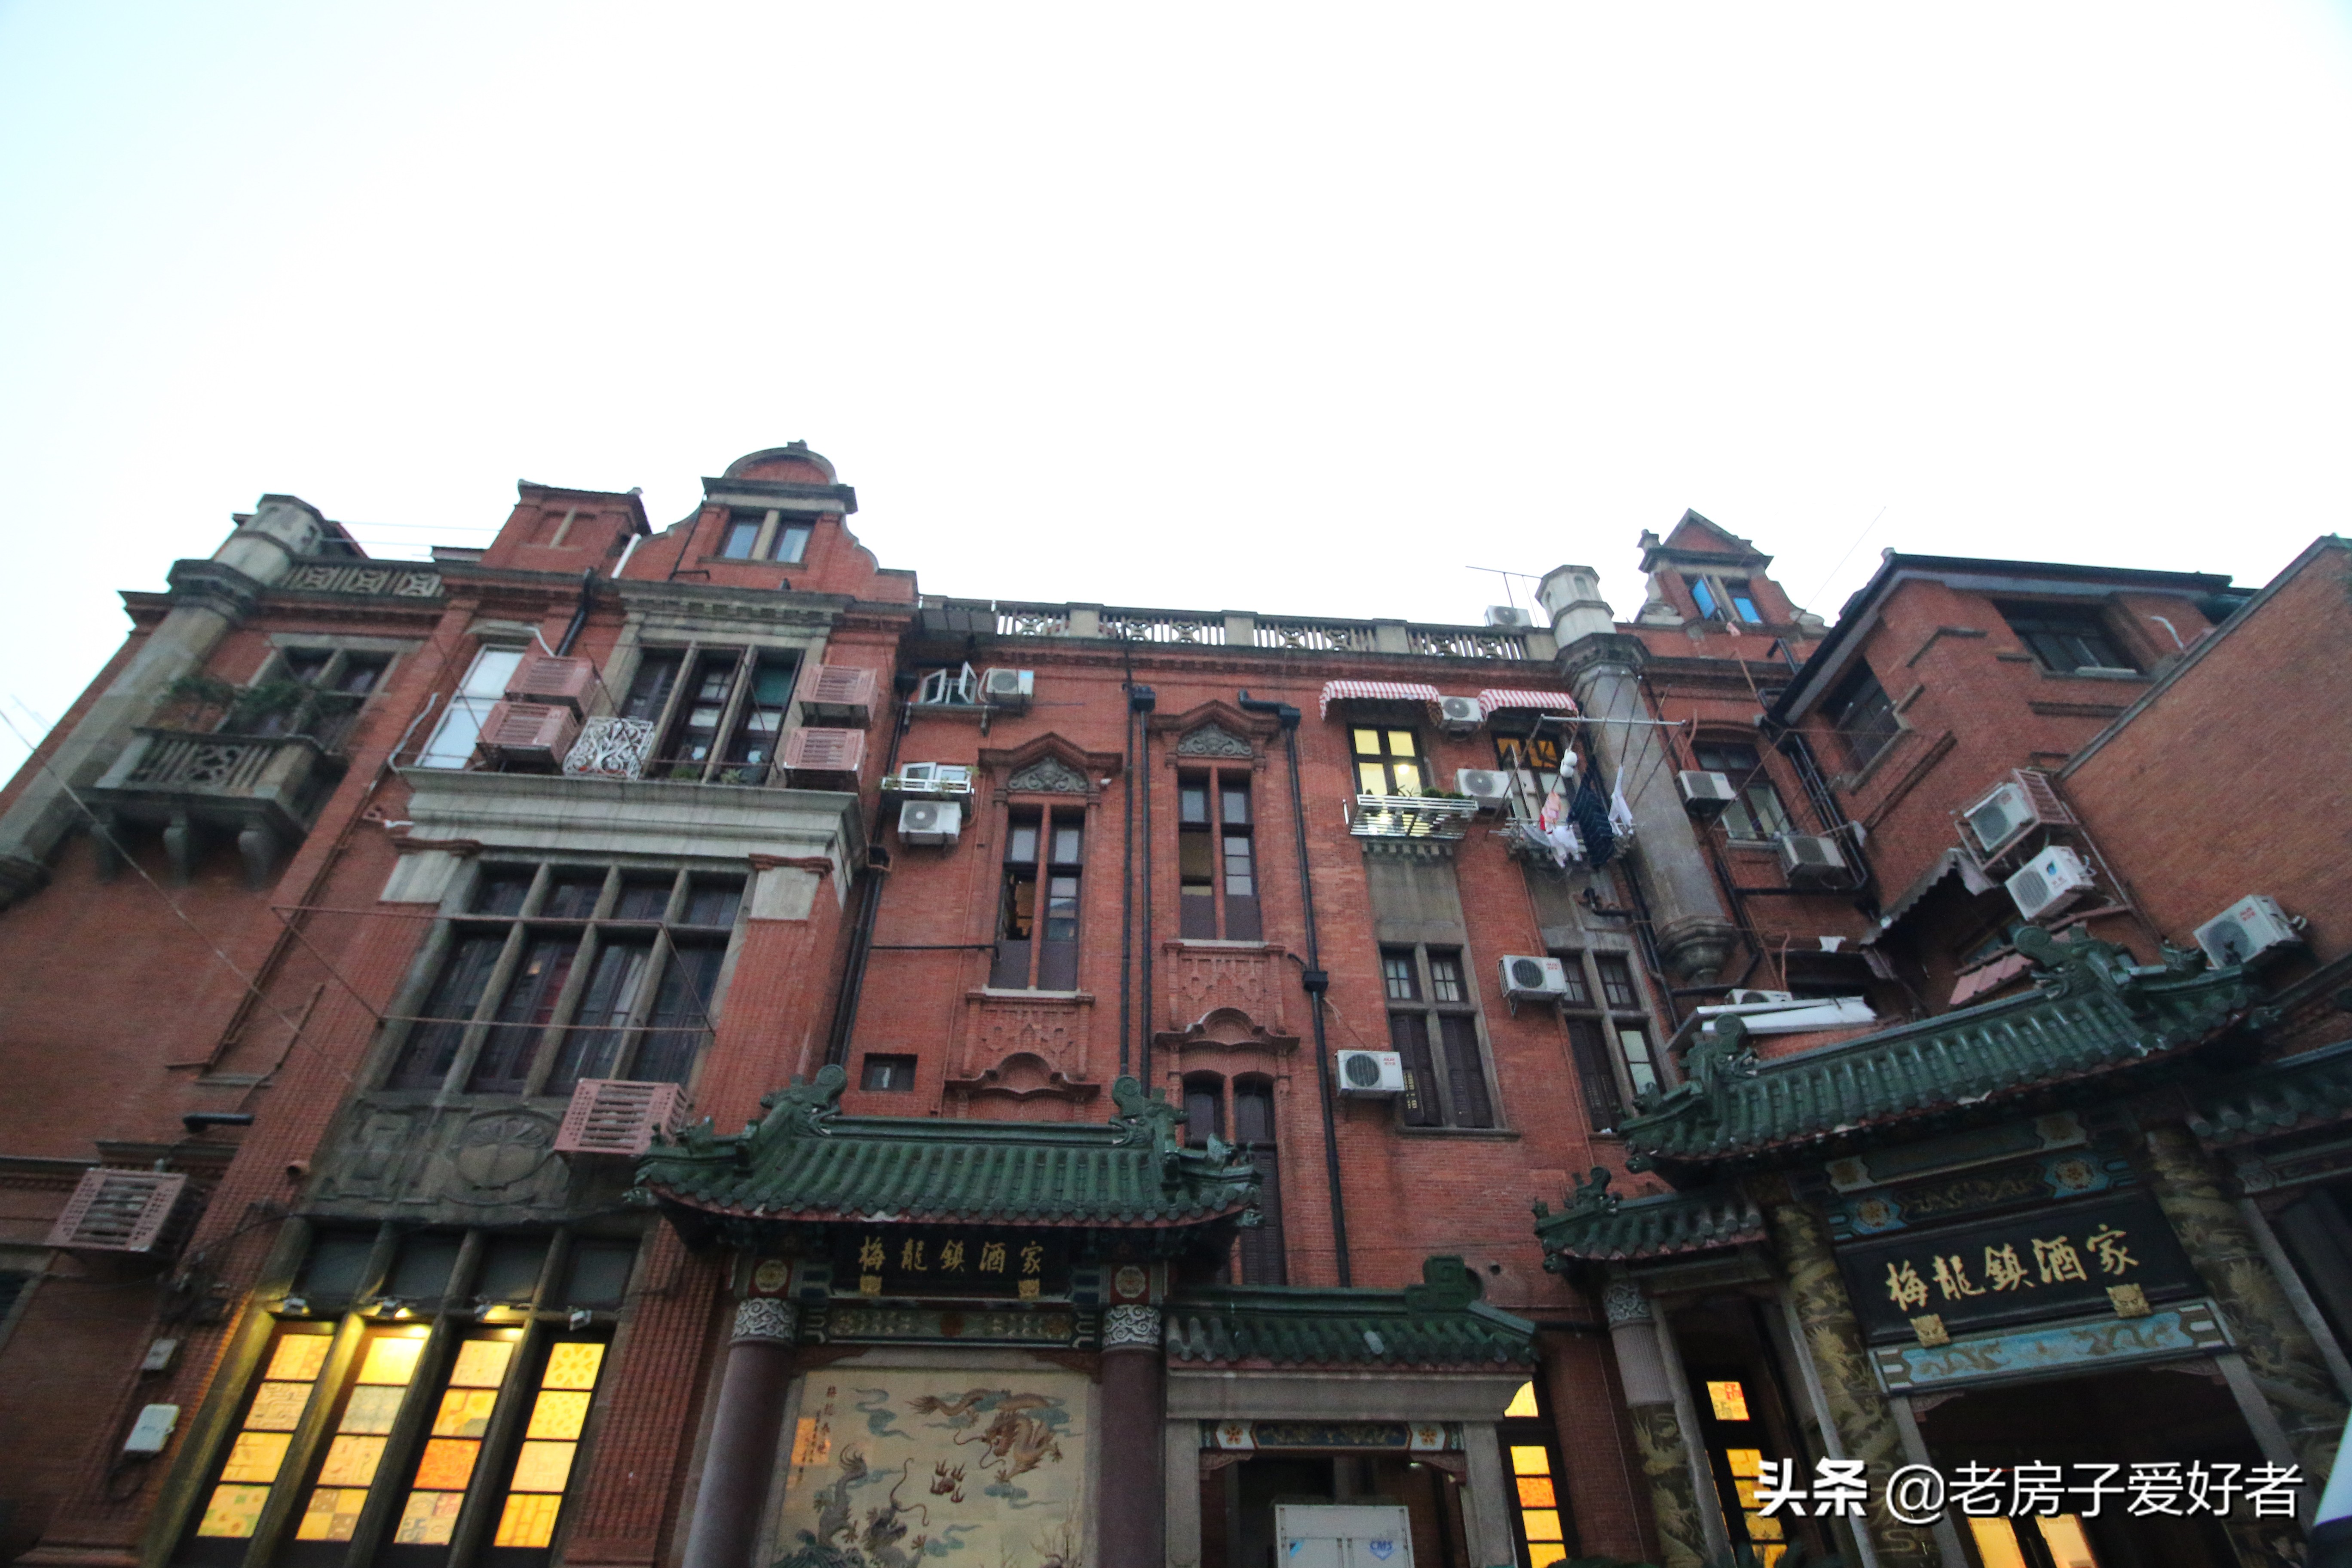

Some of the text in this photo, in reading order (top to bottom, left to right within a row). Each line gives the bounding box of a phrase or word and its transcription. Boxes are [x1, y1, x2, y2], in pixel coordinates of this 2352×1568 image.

[859, 1235, 1044, 1275] 梅龍鎮酒家
[1886, 1224, 2139, 1311] 梅龍鎮酒家
